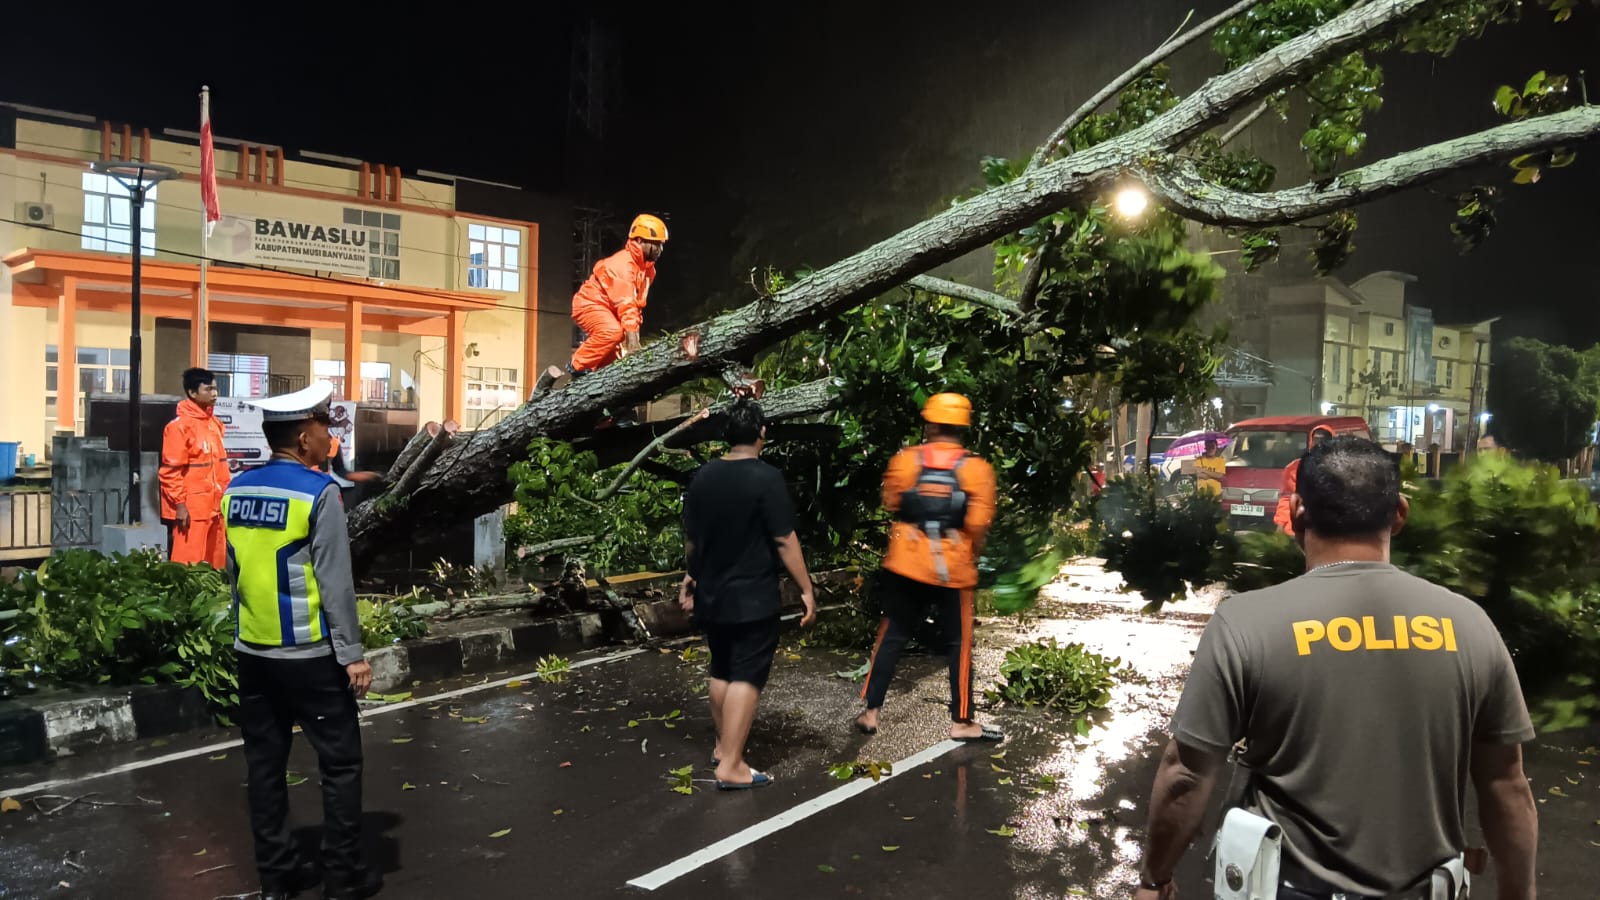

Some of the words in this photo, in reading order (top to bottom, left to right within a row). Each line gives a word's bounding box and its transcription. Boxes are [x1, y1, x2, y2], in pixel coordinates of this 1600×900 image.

[255, 218, 366, 247] BAWASLU
[255, 243, 302, 255] KABUPATEN
[303, 248, 321, 257] MUSI
[322, 250, 365, 262] BANYUASIN
[229, 499, 287, 524] POLISI
[1292, 615, 1458, 656] POLISI
